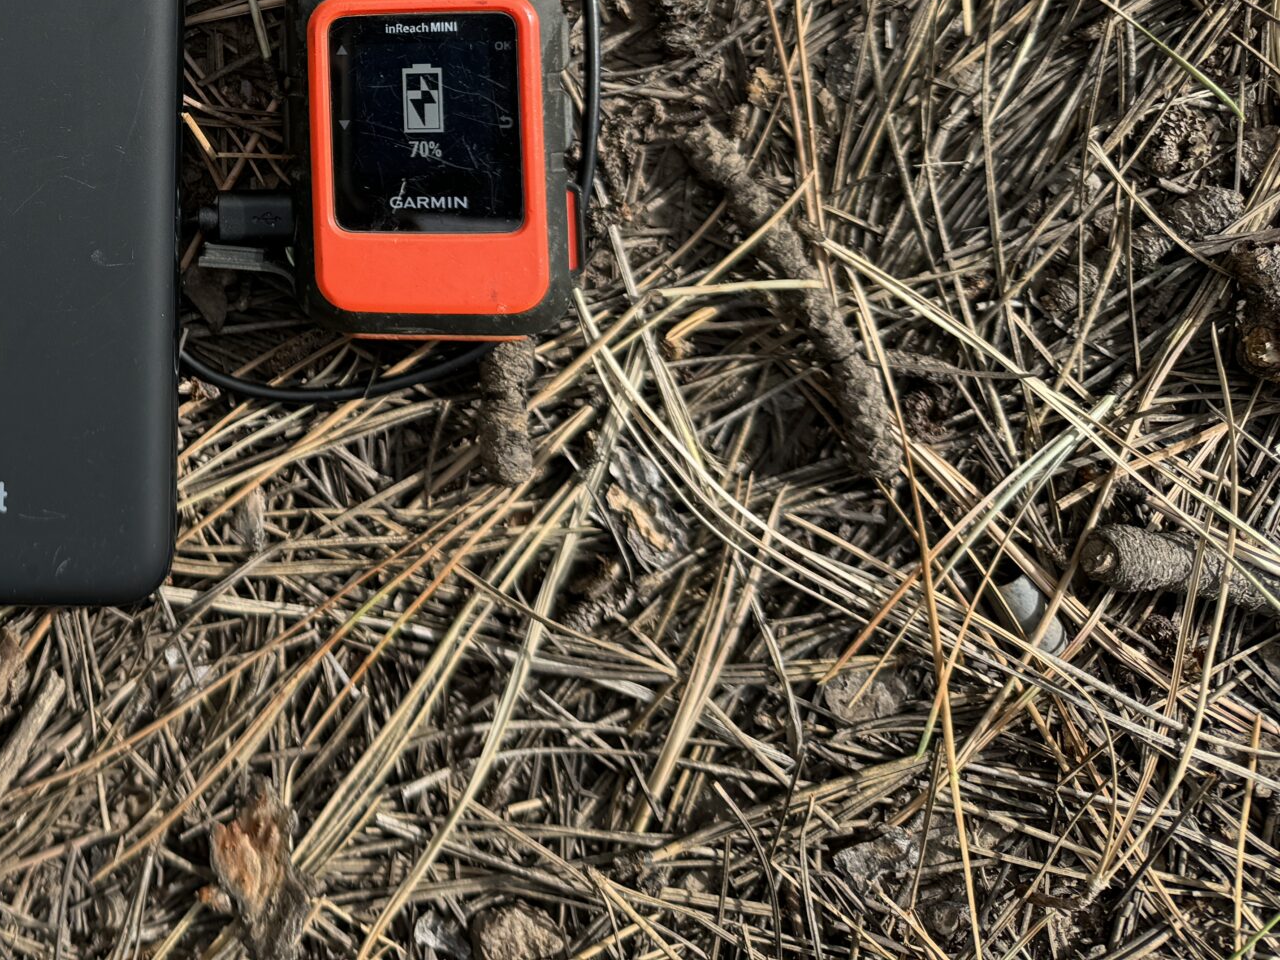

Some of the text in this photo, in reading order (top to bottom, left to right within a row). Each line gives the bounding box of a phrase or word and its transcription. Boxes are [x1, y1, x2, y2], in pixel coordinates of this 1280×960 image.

[385, 21, 458, 34] inReach MINI
[494, 41, 512, 51] OK
[408, 140, 442, 158] 70%
[389, 196, 468, 209] GARMIN
